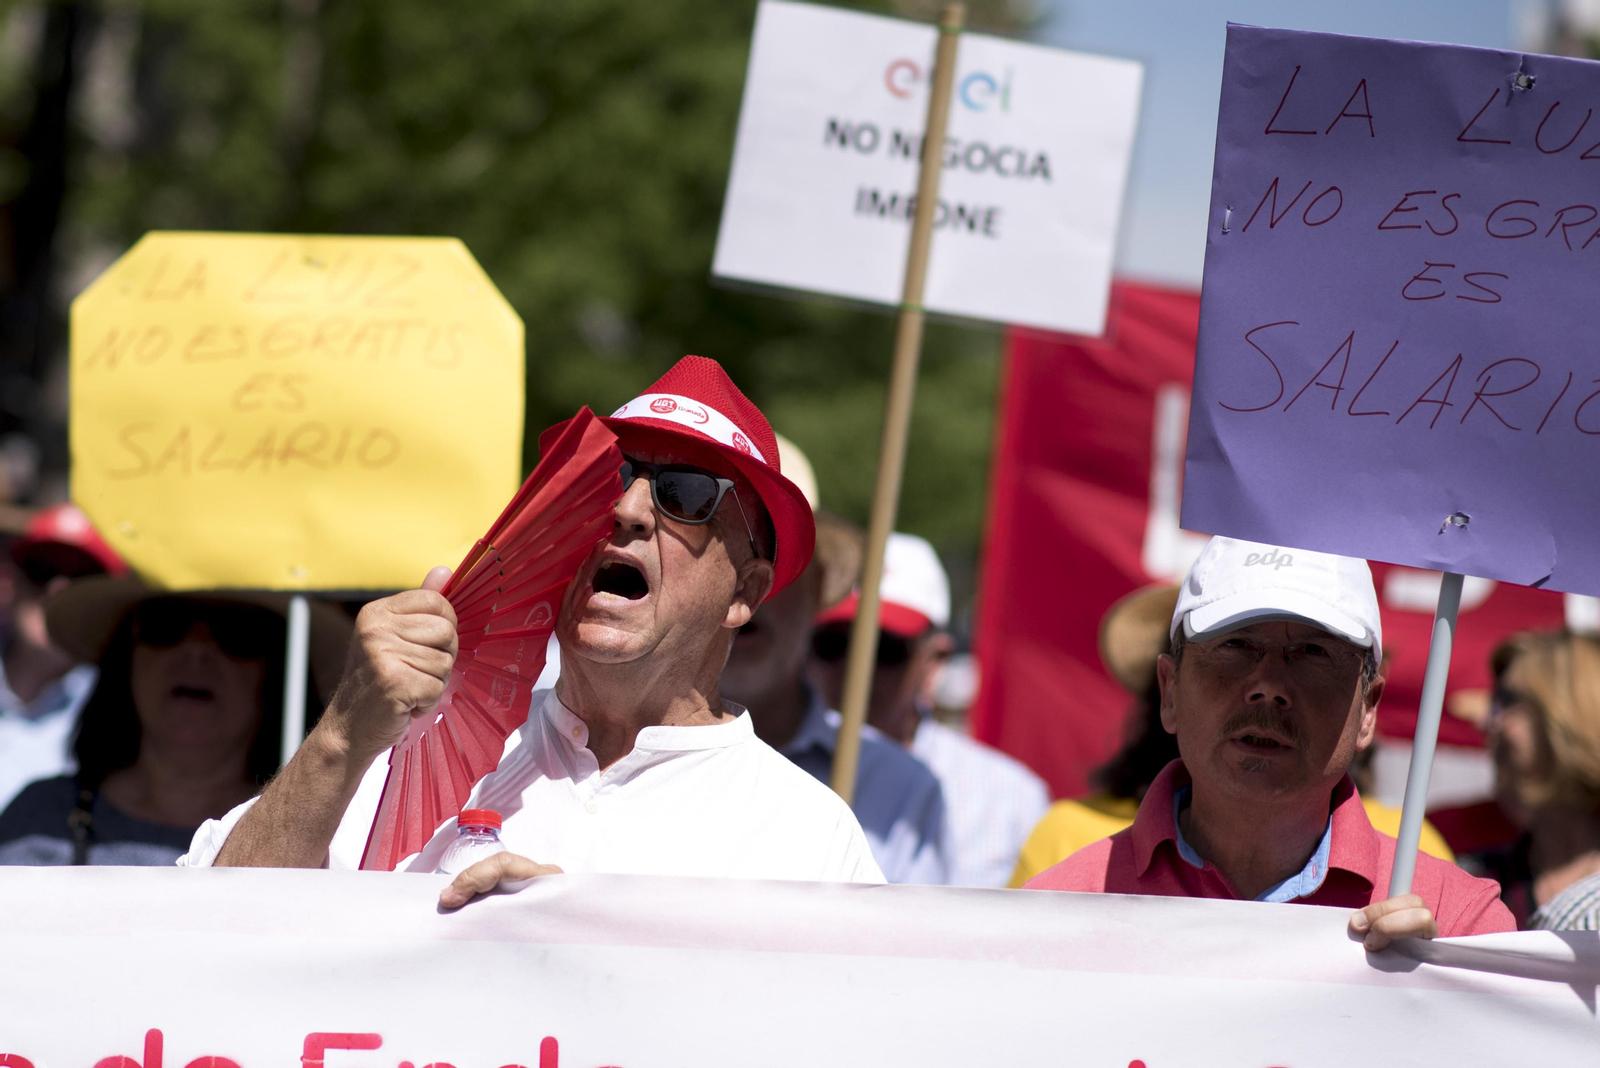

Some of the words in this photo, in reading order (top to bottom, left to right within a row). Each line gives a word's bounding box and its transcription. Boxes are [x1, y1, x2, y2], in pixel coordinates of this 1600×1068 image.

[884, 57, 1015, 114] eel
[1264, 64, 1375, 138] LA
[824, 117, 880, 155] NO
[890, 128, 1052, 183] NGOCIA
[1242, 176, 1344, 233] NO
[143, 254, 208, 303] LA
[243, 247, 424, 308] LUZ
[1401, 260, 1510, 305] ES
[83, 324, 173, 371] NO
[232, 371, 309, 414] ES
[678, 405, 704, 419] Granada
[104, 419, 402, 482] SALARIO
[1243, 548, 1294, 571] edp
